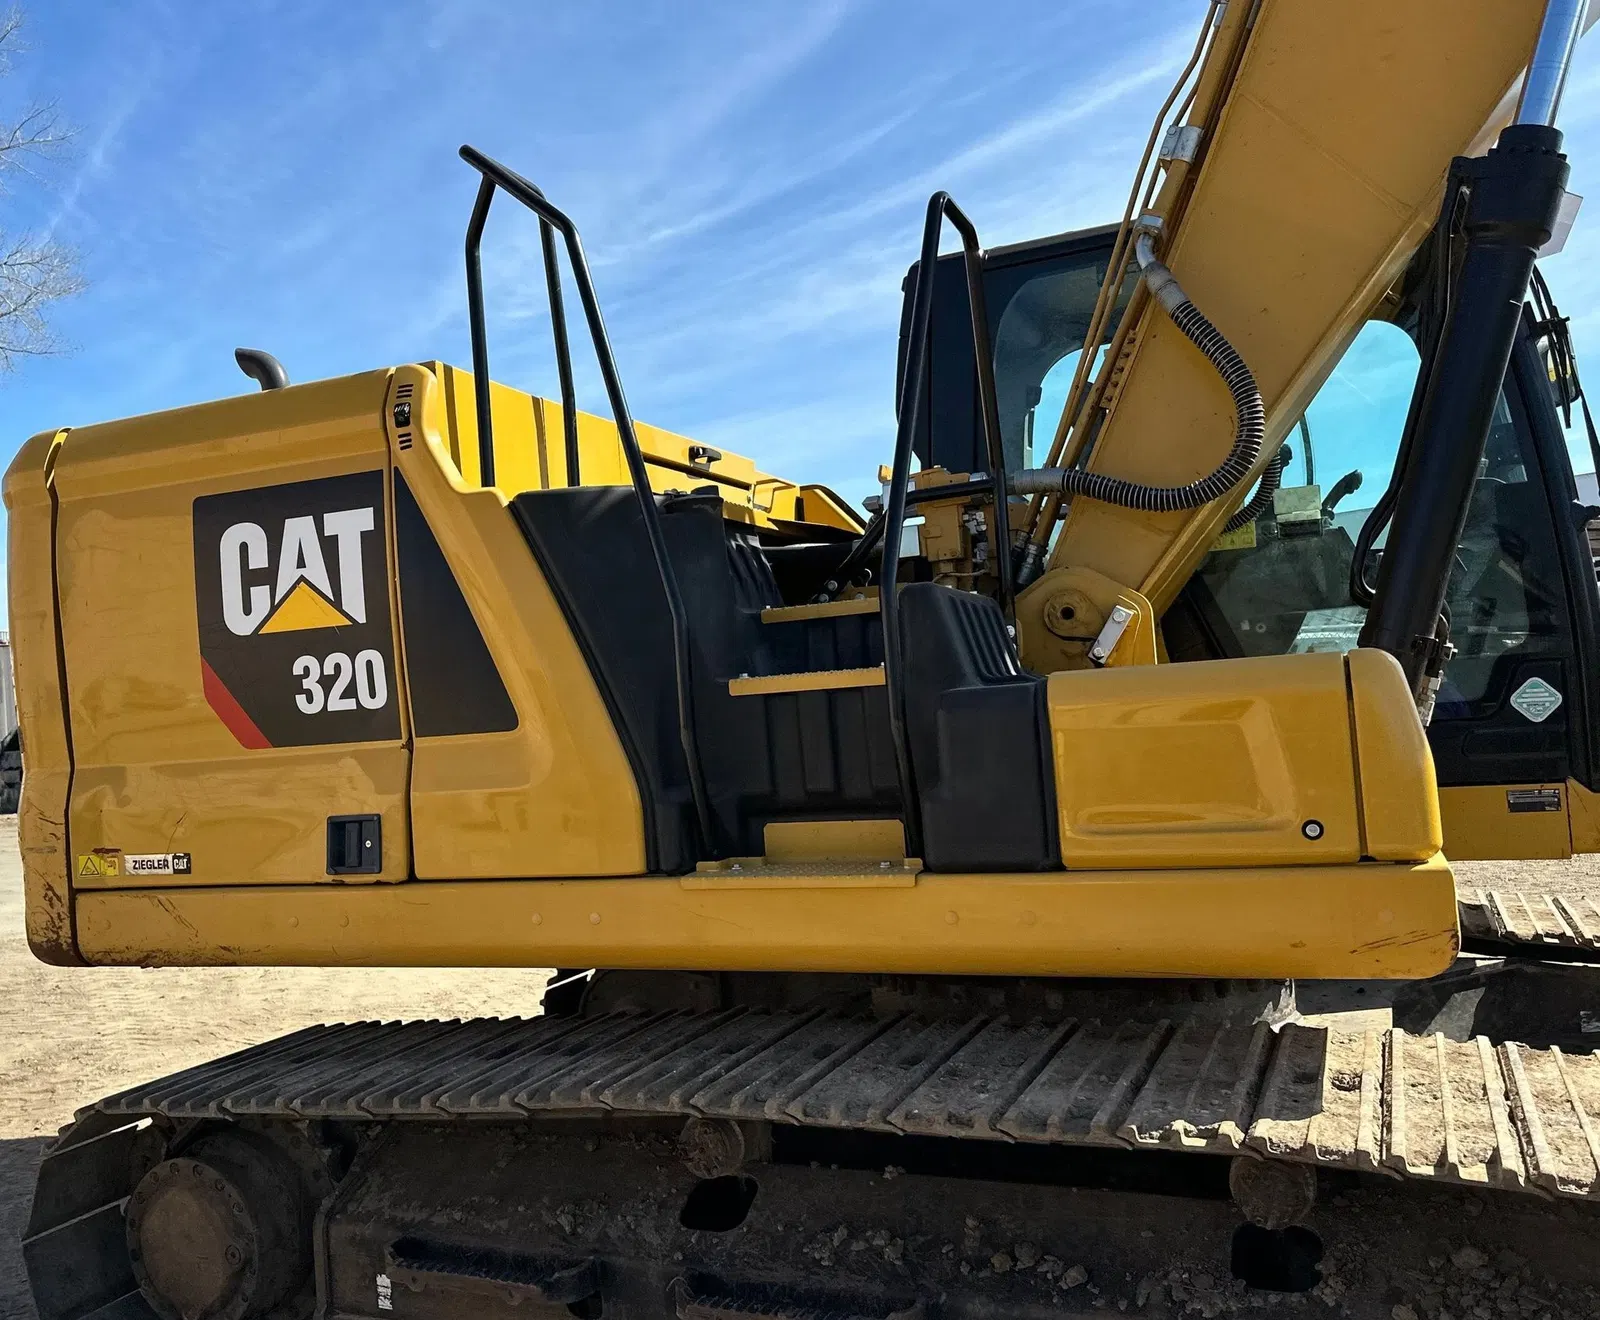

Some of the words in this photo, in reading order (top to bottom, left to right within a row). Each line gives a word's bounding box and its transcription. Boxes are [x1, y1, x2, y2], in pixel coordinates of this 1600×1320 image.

[220, 507, 375, 636] CAT
[293, 649, 388, 714] 320
[132, 859, 170, 870] ZIEGLER
[173, 858, 188, 870] CAT
